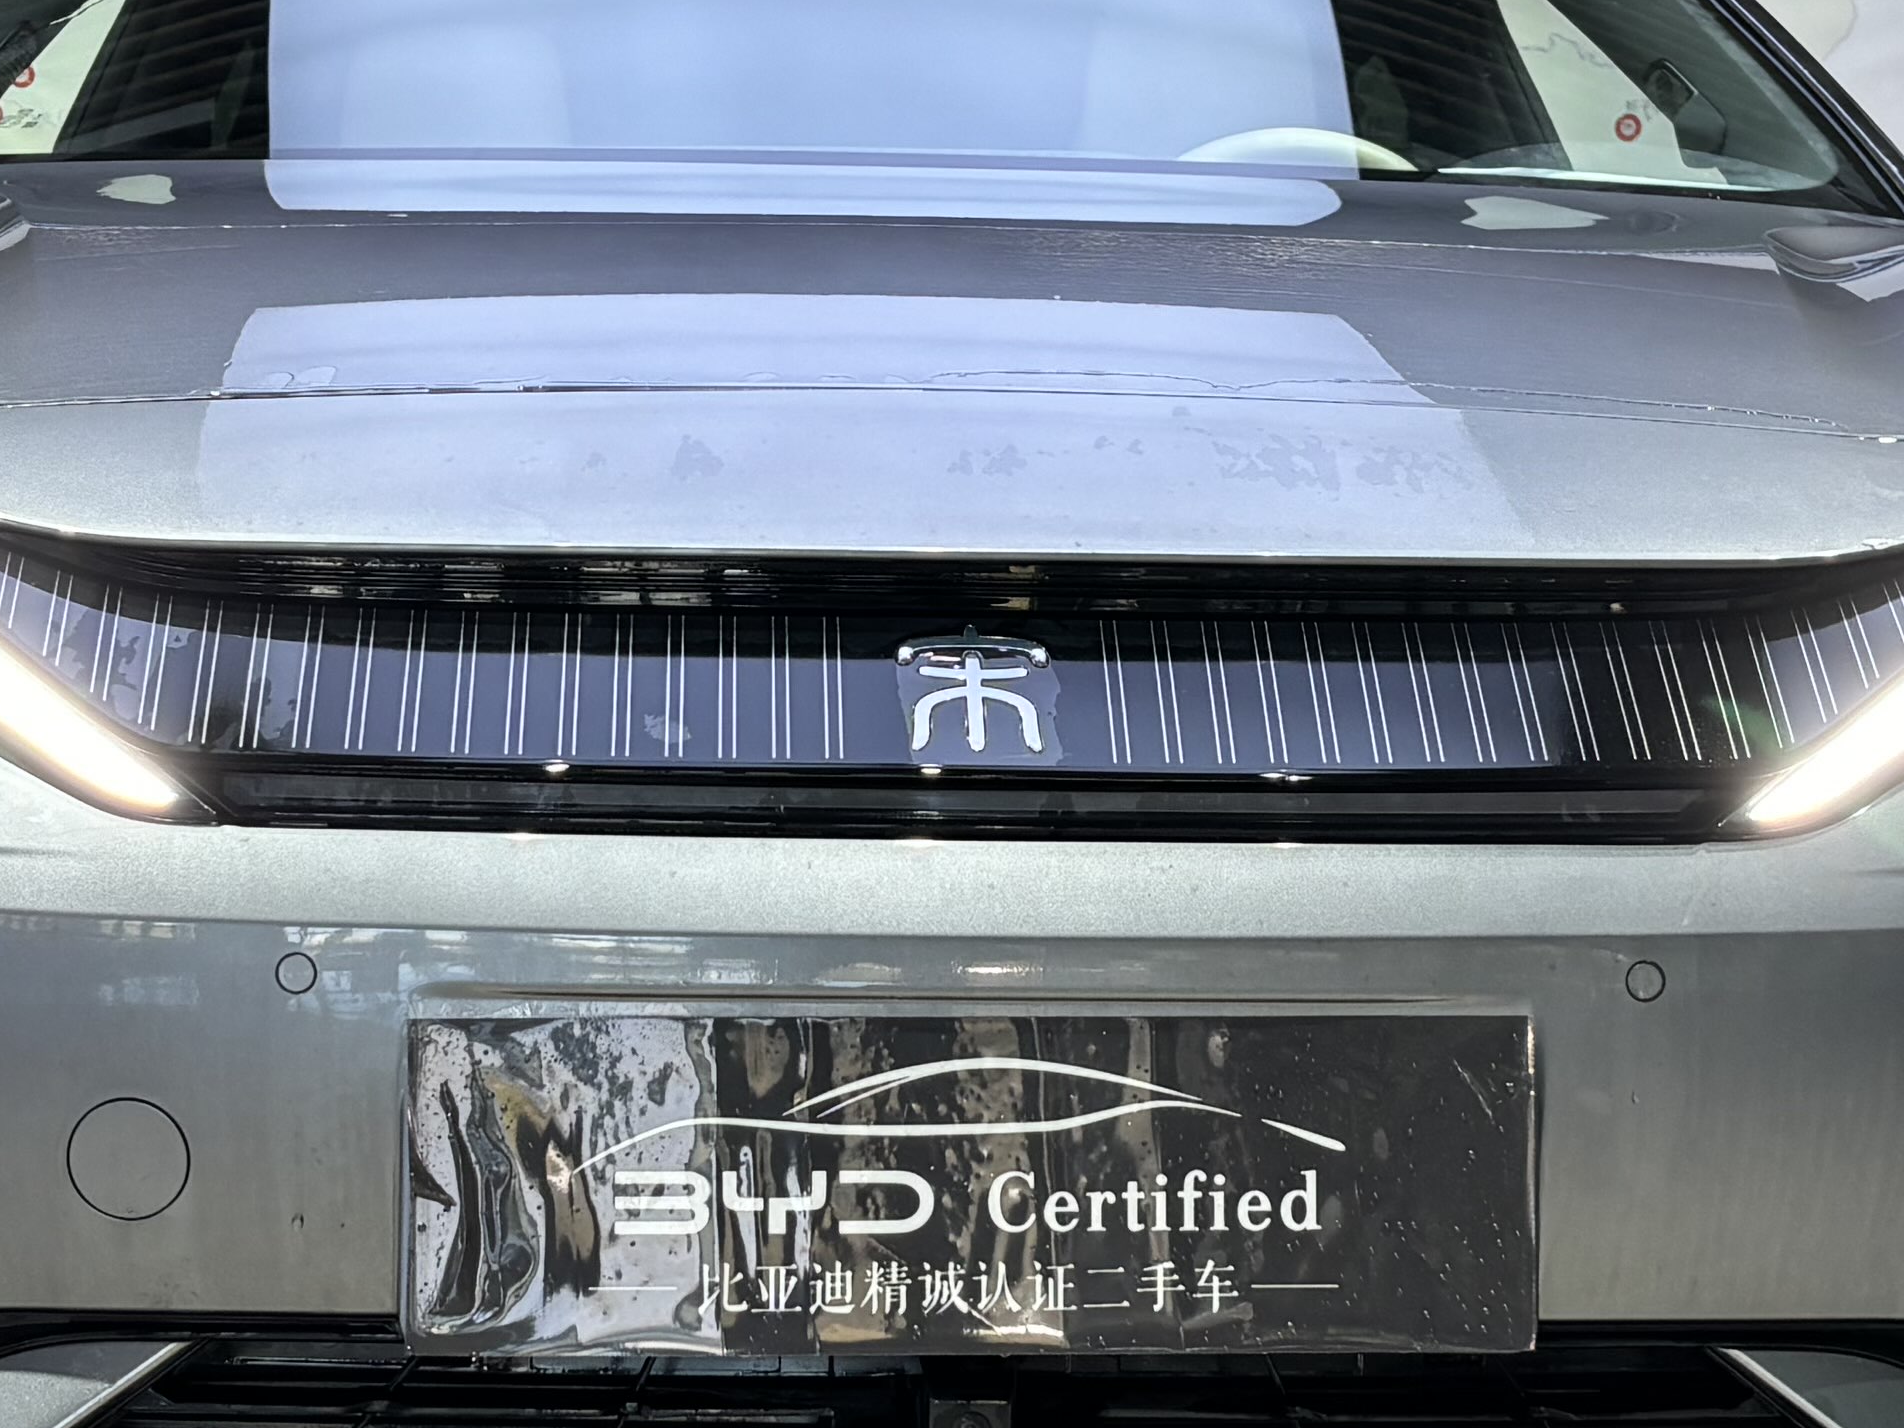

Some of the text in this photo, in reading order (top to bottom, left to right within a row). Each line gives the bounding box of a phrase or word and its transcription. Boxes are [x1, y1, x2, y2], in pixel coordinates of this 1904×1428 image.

[614, 1169, 1322, 1235] BYD Certified
[698, 1259, 1239, 1315] 比亚迪精诚认证二手车
